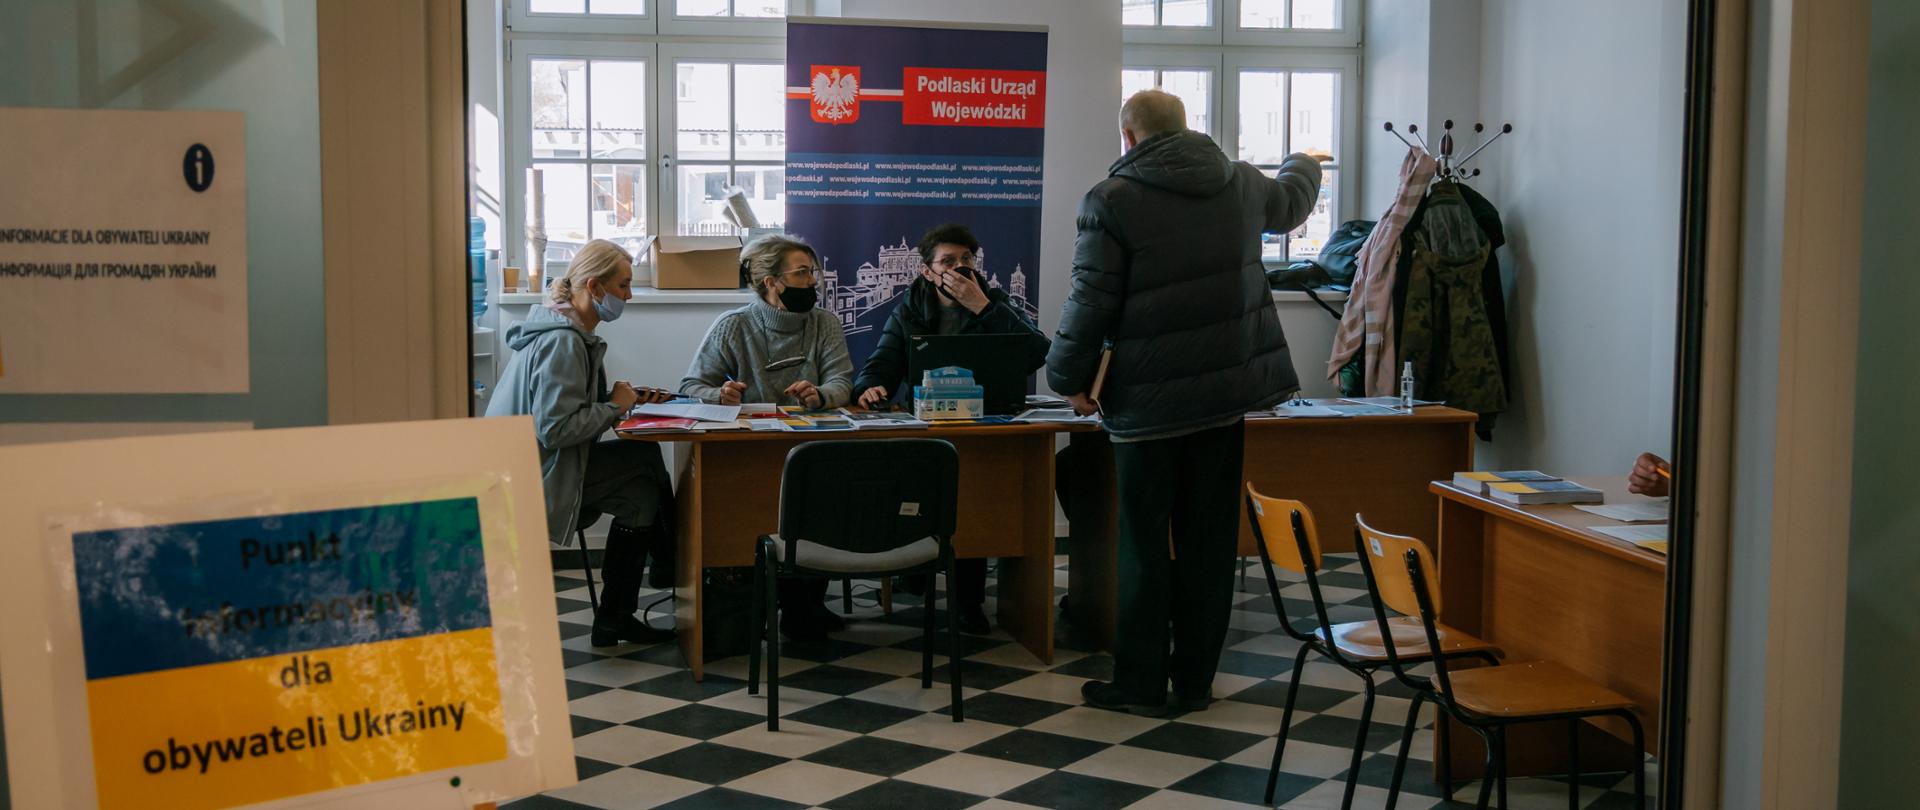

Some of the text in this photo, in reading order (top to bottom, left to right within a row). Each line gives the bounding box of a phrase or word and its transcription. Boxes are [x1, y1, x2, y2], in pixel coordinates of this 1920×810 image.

[917, 76, 1036, 100] Podlaski Urząd
[931, 101, 1026, 123] Wojewódzki
[786, 162, 1041, 173] www.wojewodapodlaski.pl www.wojewodapodlaski.pl www.wojewodapodlaski.pl
[830, 176, 911, 185] www.wojewodapodlaski.pl
[916, 177, 997, 185] www.wojewodapodlaski.pl
[786, 189, 1041, 200] www.wojewodapodlaski.pl www.wojewodapodlaski.pl www.wojewodapodlaski.pl
[71, 229, 94, 244] DLA
[96, 229, 159, 244] OBYWATELI
[162, 230, 210, 244] UKRAINY
[0, 261, 217, 280] НФОРМАЦІЯ ДЛЯ ГРОМАДЯН УКРАЇНИ
[240, 530, 342, 570] Punkt
[184, 586, 418, 640] informacyjny
[280, 654, 332, 690] dla
[143, 698, 467, 776] obywateli Ukrainy
